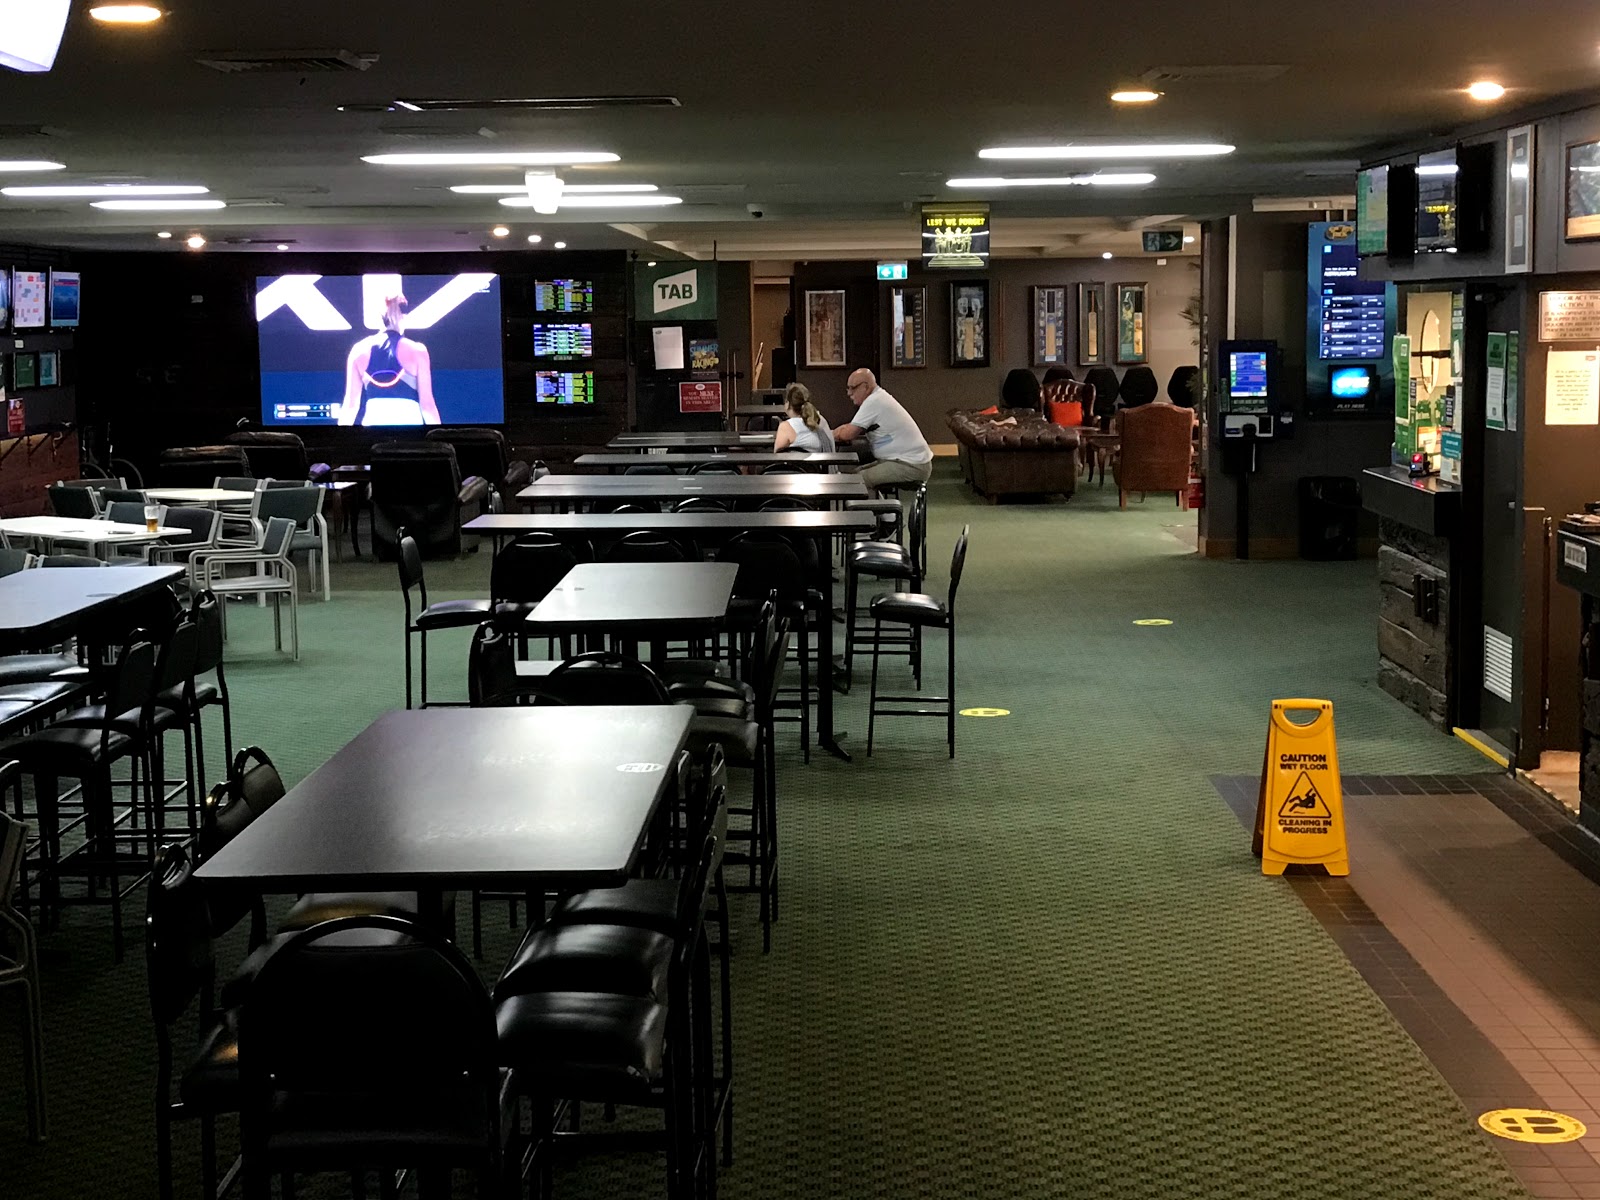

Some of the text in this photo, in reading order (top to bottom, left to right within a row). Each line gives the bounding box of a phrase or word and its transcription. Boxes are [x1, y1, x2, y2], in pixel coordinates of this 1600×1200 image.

[926, 217, 985, 226] LEST WE FORGET
[658, 284, 693, 299] TAB
[690, 343, 719, 357] SUMMER
[1280, 753, 1327, 763] CAUTION
[1280, 763, 1329, 771] WET FLOOR
[1278, 818, 1332, 827] CLEANING IN
[1282, 826, 1328, 834] PROGRESS
